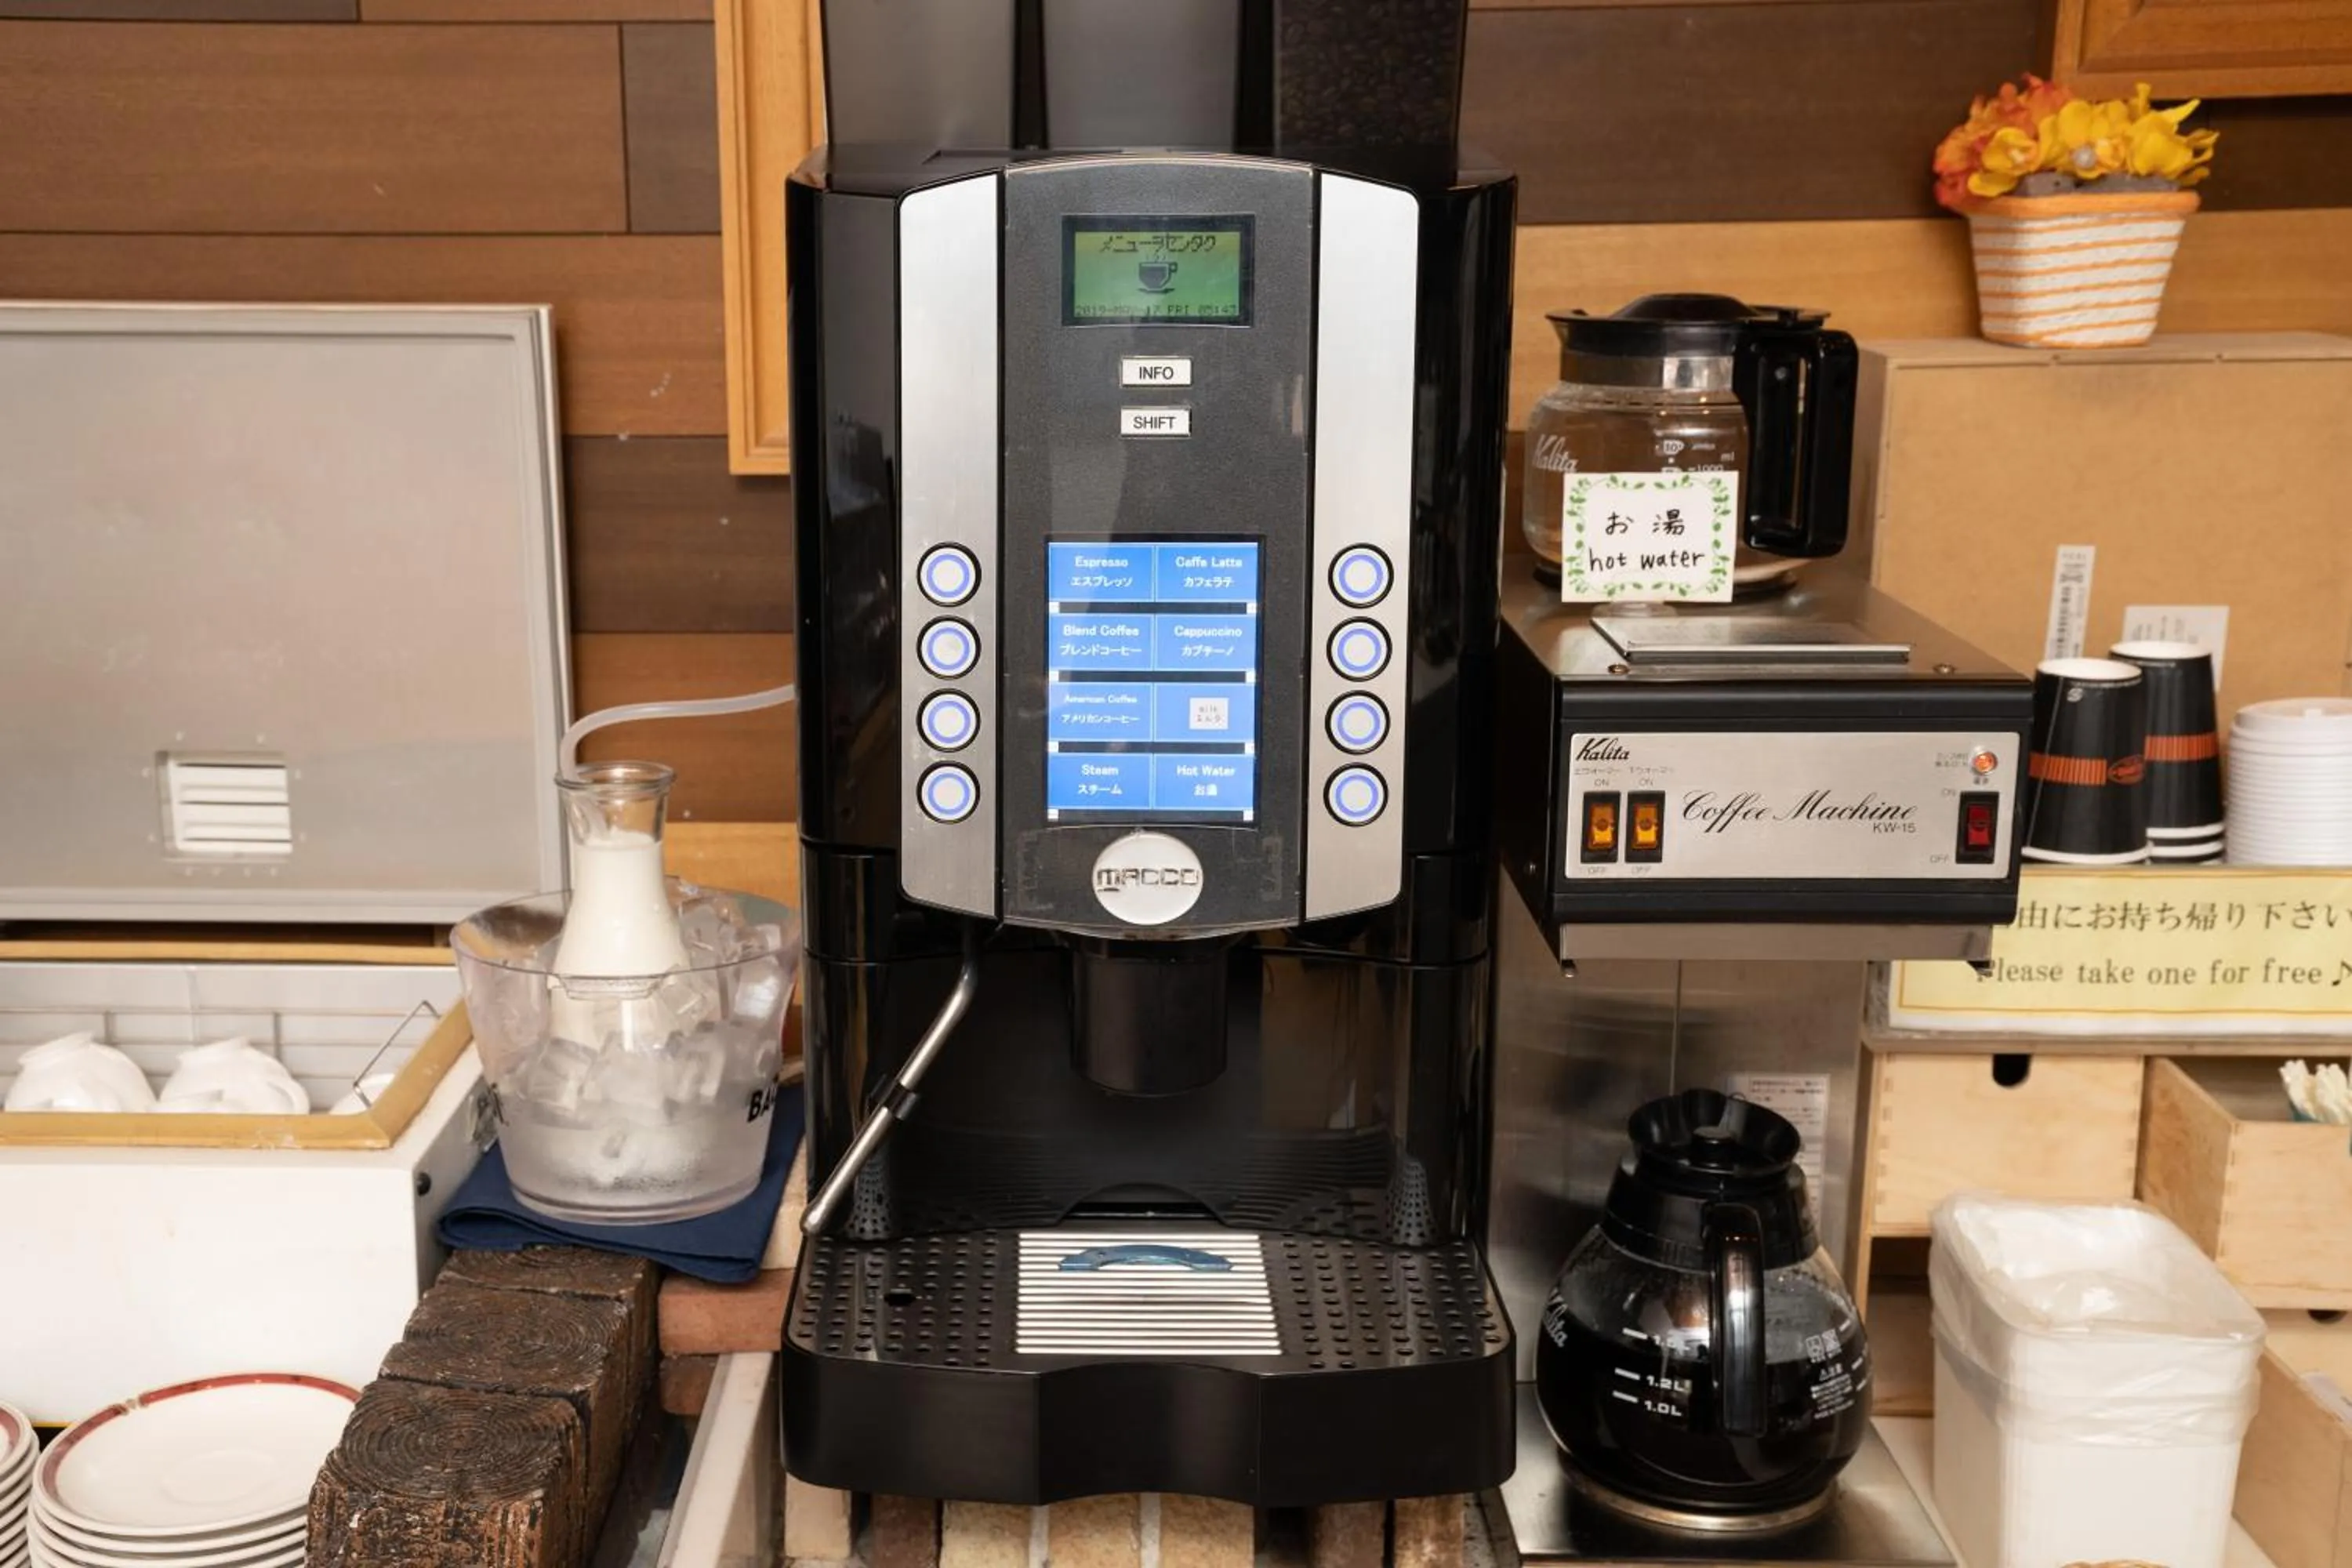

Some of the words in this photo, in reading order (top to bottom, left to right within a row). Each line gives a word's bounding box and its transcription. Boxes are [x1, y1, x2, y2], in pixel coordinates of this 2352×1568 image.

[1139, 366, 1174, 379] INFO
[1133, 416, 1176, 429] SHIFT
[1606, 510, 1686, 535] お湯
[1075, 556, 1129, 570] Espresso
[1211, 556, 1243, 568] Latte
[1589, 547, 1627, 572] hot
[1641, 549, 1705, 570] water
[1070, 576, 1133, 587] エスプレッソ
[1184, 576, 1234, 587] カフェラテ
[1063, 625, 1097, 636] Blend
[1100, 625, 1140, 637] Coffee
[1174, 625, 1243, 638] Cappuccino
[1060, 645, 1142, 656] ブレンドコーヒー
[1108, 695, 1138, 704] Coffee
[1576, 737, 1631, 761] Kalita
[1081, 764, 1119, 776] Steam
[1177, 764, 1198, 776] Hot
[1201, 764, 1236, 776] Water
[1682, 790, 1770, 833] Coffee
[1773, 790, 1918, 821] Machine
[1873, 822, 1916, 833] KW-15
[1996, 901, 2352, 931] 由にお持ち帰り下さい
[2078, 959, 2134, 984] take
[2147, 964, 2197, 985] one
[2211, 959, 2250, 985] for
[2262, 958, 2322, 984] free
[1646, 1374, 1685, 1392] 1.2L
[1644, 1400, 1682, 1416] 1.0L
